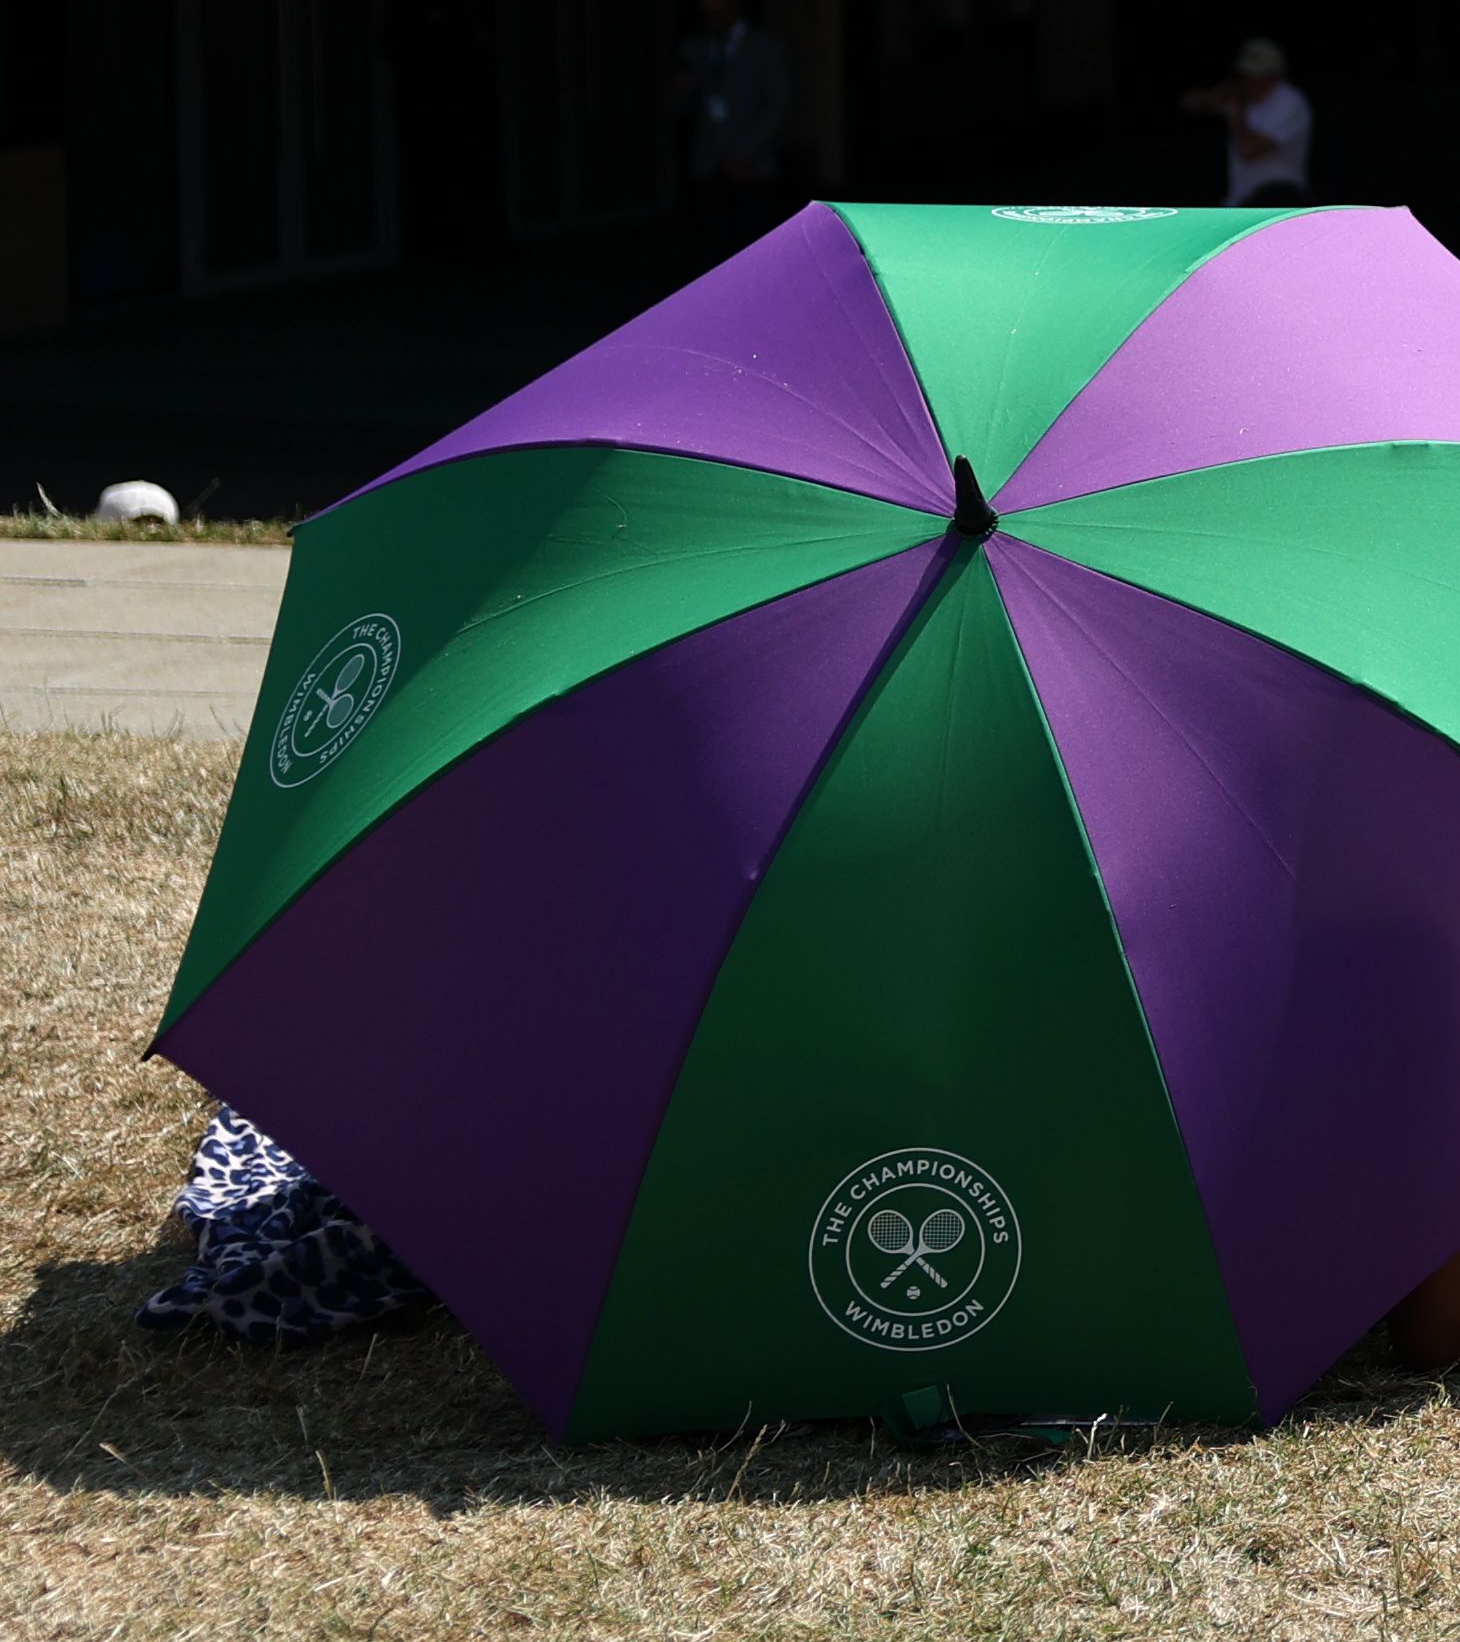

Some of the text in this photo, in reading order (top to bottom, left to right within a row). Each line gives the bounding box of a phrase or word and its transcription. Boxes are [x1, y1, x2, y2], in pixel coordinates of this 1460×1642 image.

[277, 673, 316, 774] WIMBLEDON
[319, 623, 393, 764] THE CHAMPIONSHIPS
[822, 1159, 1009, 1246] THE CHAMPIONSHIPS
[844, 1298, 985, 1340] WIMBLEDON
